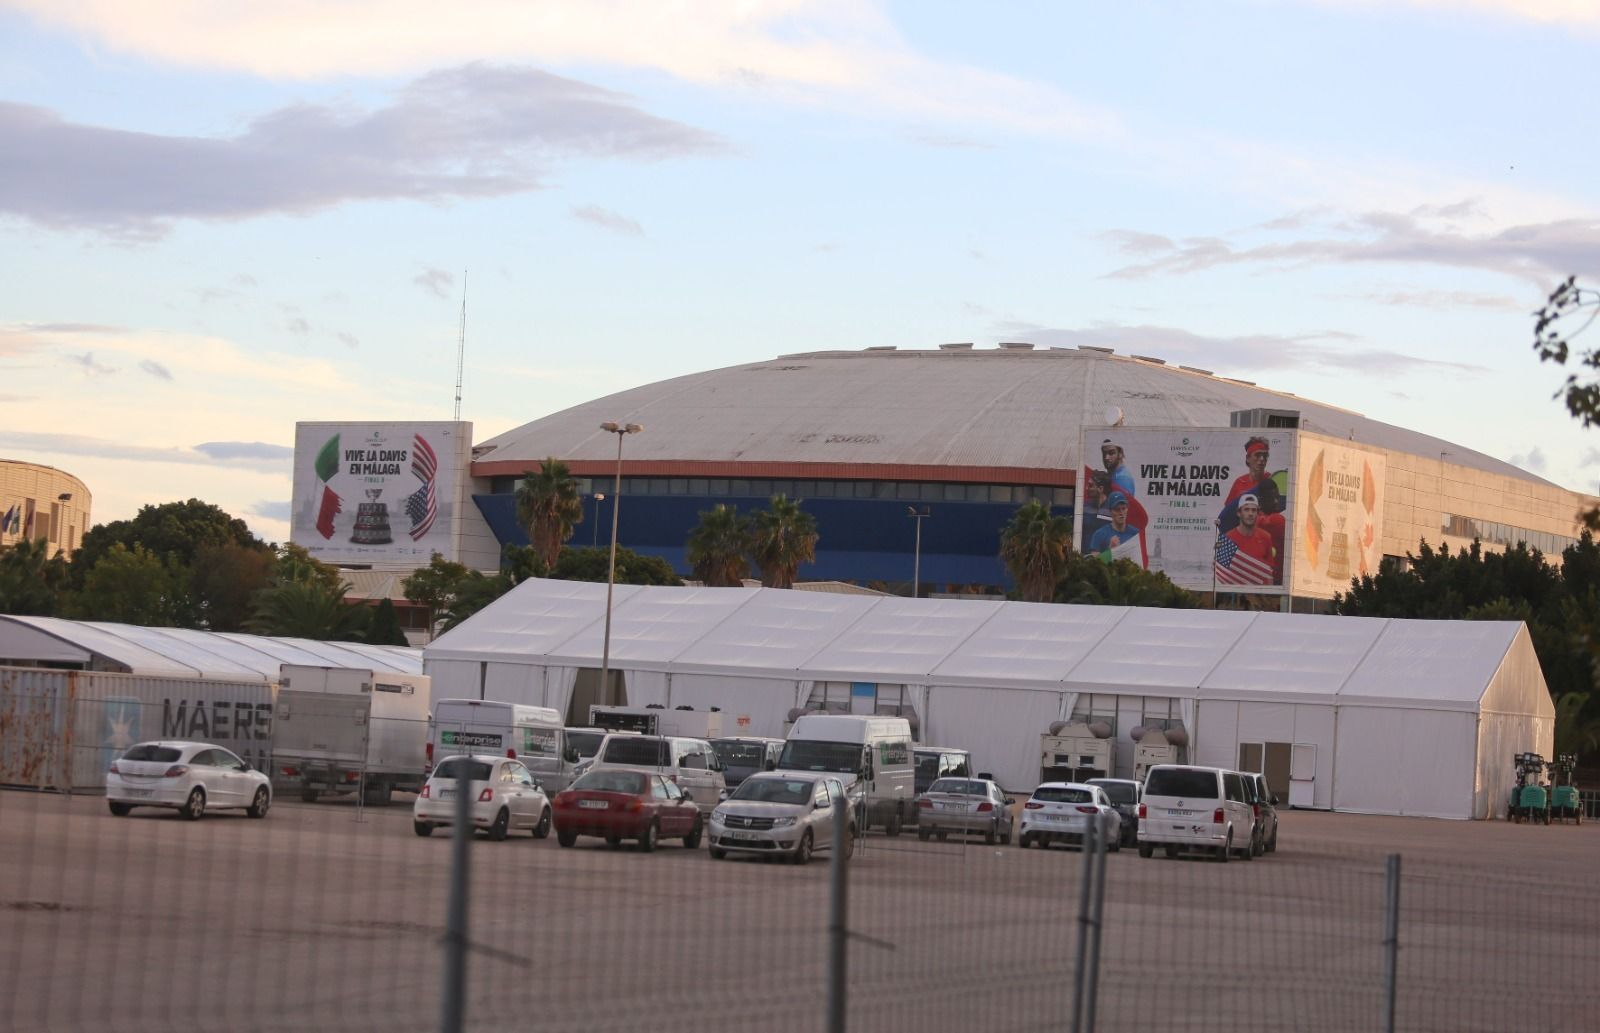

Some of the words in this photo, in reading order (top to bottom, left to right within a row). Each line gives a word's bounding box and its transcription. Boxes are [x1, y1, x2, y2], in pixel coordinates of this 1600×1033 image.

[345, 450, 365, 461] VIVE
[366, 450, 377, 461] LA
[380, 450, 407, 461] DAVIS
[350, 463, 361, 475] EN
[363, 461, 401, 475] MÁLAGA
[1140, 464, 1169, 479] VIVE
[1171, 465, 1187, 479] LA
[1190, 465, 1230, 480] DAVIS
[1326, 470, 1338, 485] VIVE
[1338, 472, 1344, 486] LA
[1345, 474, 1361, 489] DAVIS
[1147, 481, 1164, 496] EN
[1166, 480, 1220, 497] MÁLAGA
[1169, 500, 1190, 508] FINAL
[444, 734, 501, 745] enterprise
